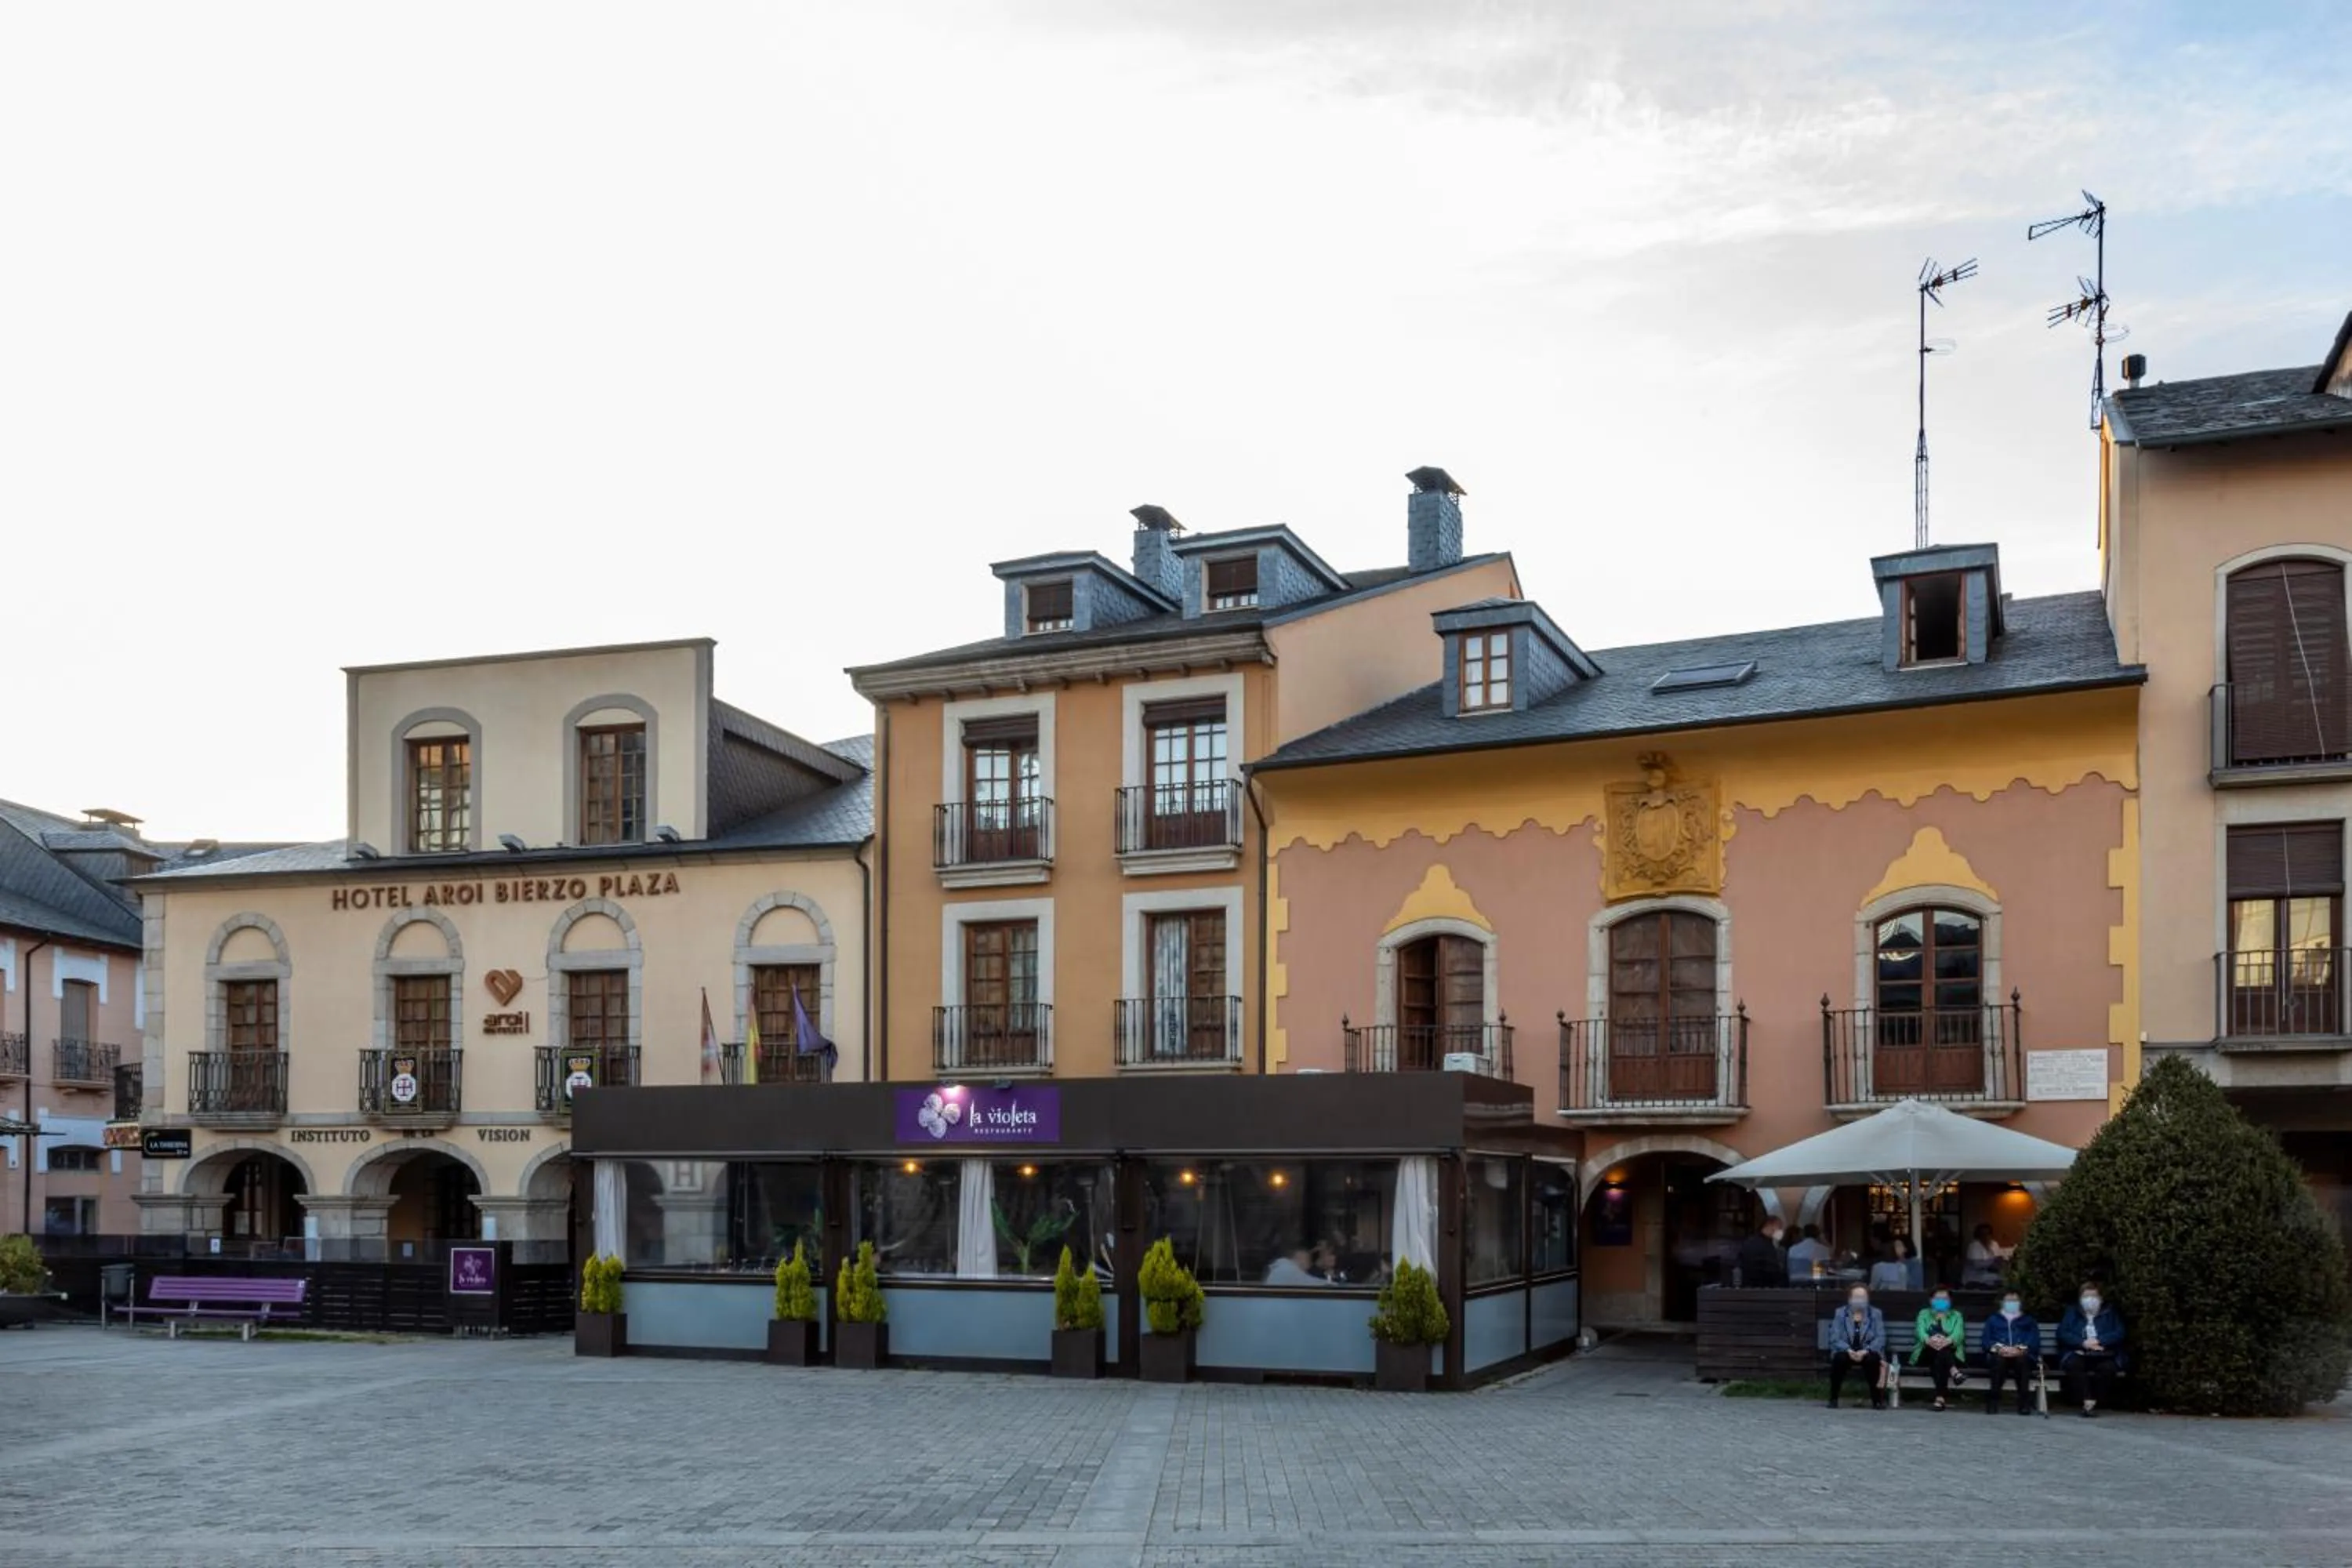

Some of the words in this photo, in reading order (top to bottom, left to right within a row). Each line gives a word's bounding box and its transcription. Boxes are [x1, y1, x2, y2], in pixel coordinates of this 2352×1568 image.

[332, 886, 412, 910] HOTEL
[423, 883, 483, 906] AROI
[495, 878, 586, 903] BIERZO
[600, 872, 680, 897] PLAZA
[484, 1011, 523, 1026] aroi
[970, 1099, 982, 1127] la
[988, 1099, 1036, 1127] violeta
[291, 1130, 370, 1142] INSTITUTO
[477, 1129, 530, 1142] VISION
